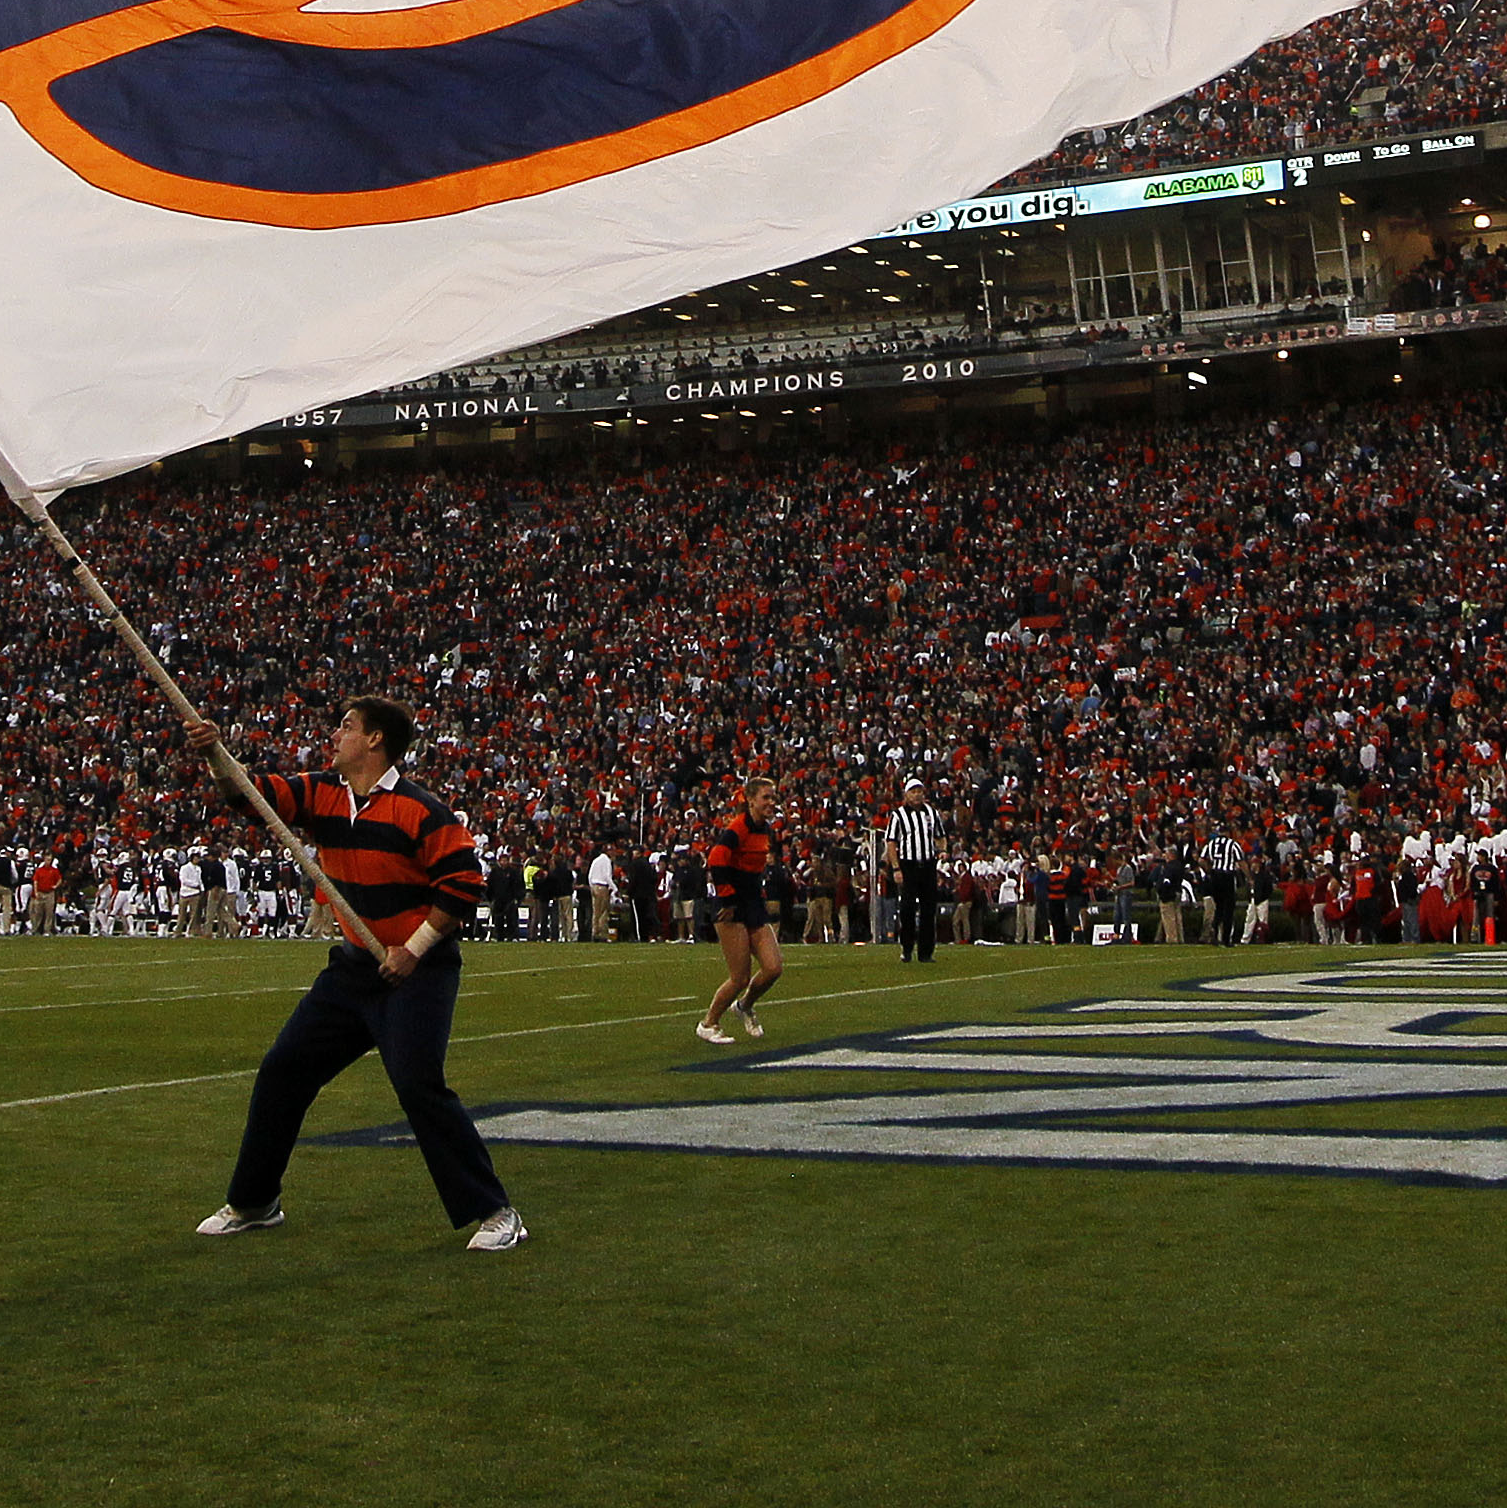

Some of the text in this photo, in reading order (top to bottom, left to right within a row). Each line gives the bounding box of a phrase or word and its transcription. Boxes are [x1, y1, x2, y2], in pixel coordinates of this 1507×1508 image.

[1145, 167, 1263, 199] ALABAMA 811
[1293, 169, 1308, 186] 2
[949, 201, 1008, 229] you
[1021, 194, 1088, 218] dig.
[281, 359, 976, 428] 1957 NATIONAL CHAMPIONS 2010
[264, 870, 272, 882] 5
